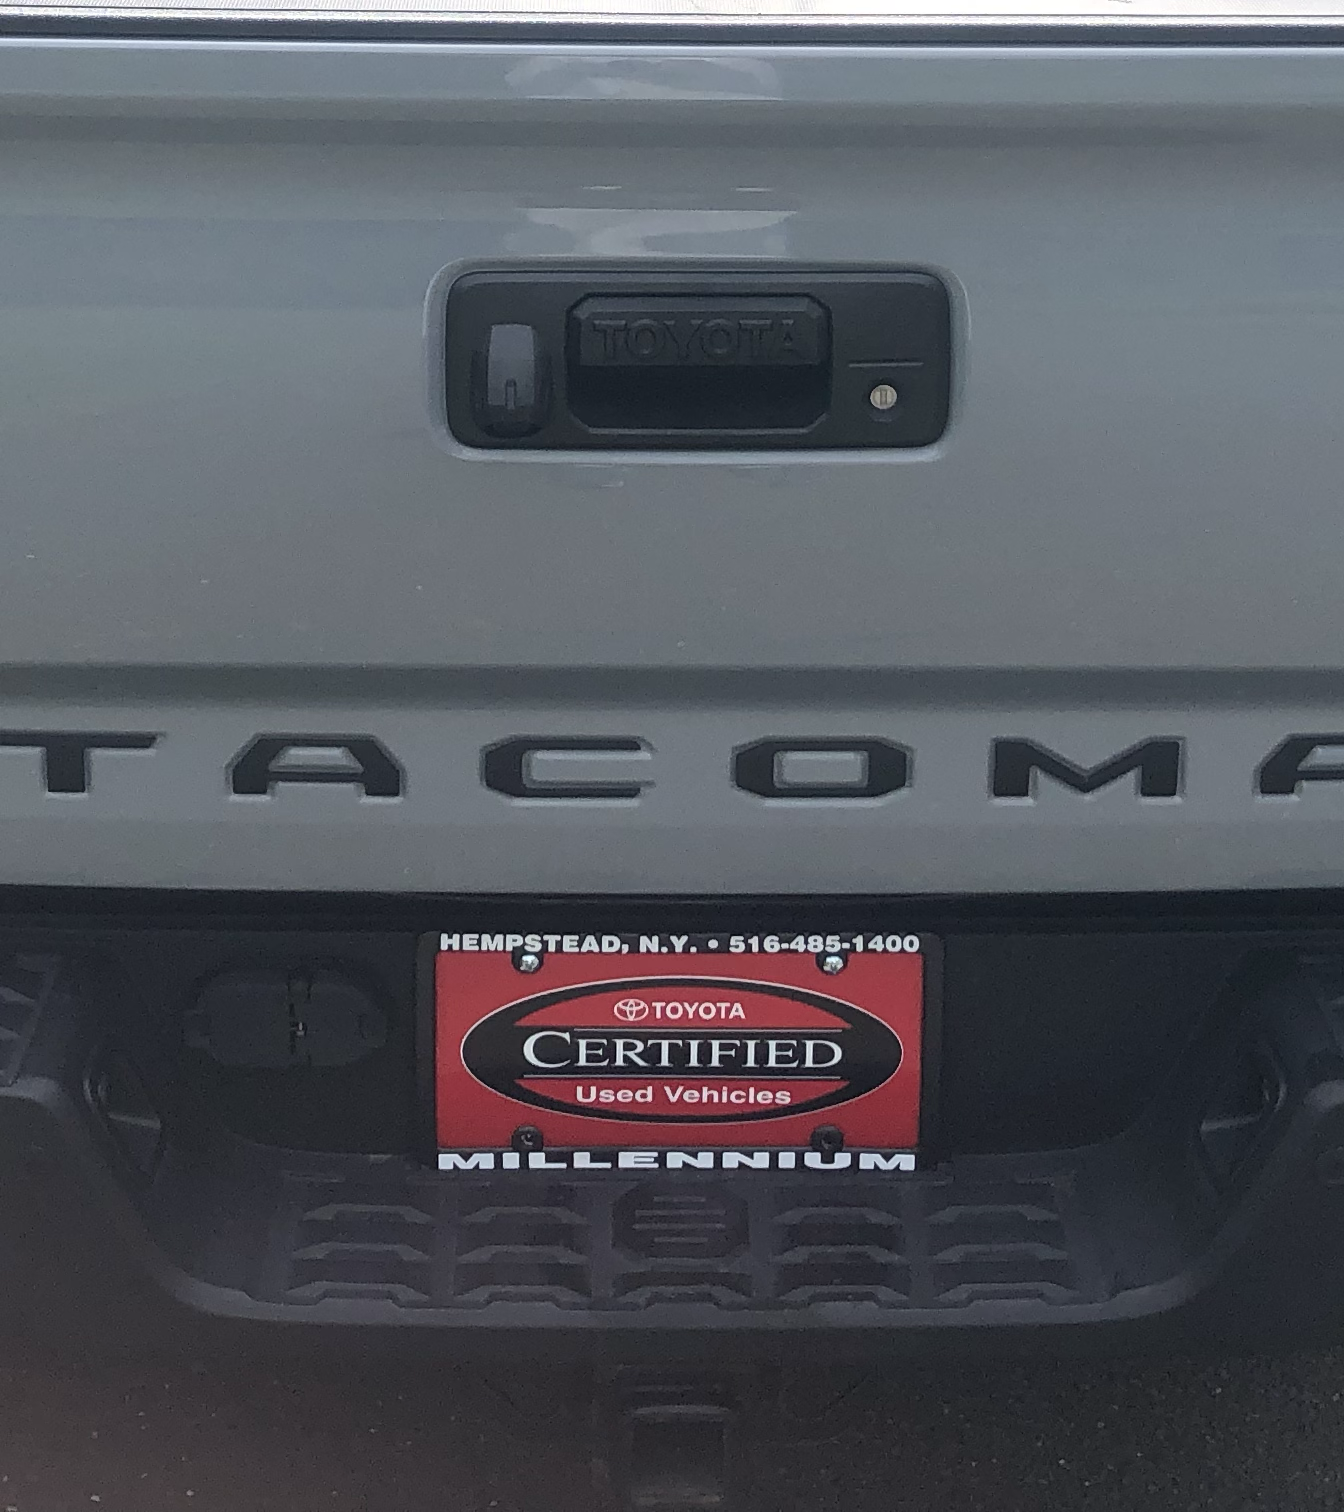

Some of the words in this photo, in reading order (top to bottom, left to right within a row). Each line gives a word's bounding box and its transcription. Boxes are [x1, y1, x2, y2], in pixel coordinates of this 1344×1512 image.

[592, 318, 804, 361] TOYOTA
[440, 933, 629, 954] HEMPSTEAD,
[639, 935, 698, 954] N.Y.
[729, 934, 920, 954] 516-485-1400
[651, 1000, 746, 1021] TOYOTA
[522, 1030, 843, 1069] CERTIFIED
[576, 1085, 653, 1104] Used
[663, 1085, 792, 1105] Vehicles
[438, 1151, 916, 1171] MILLENNIUM
